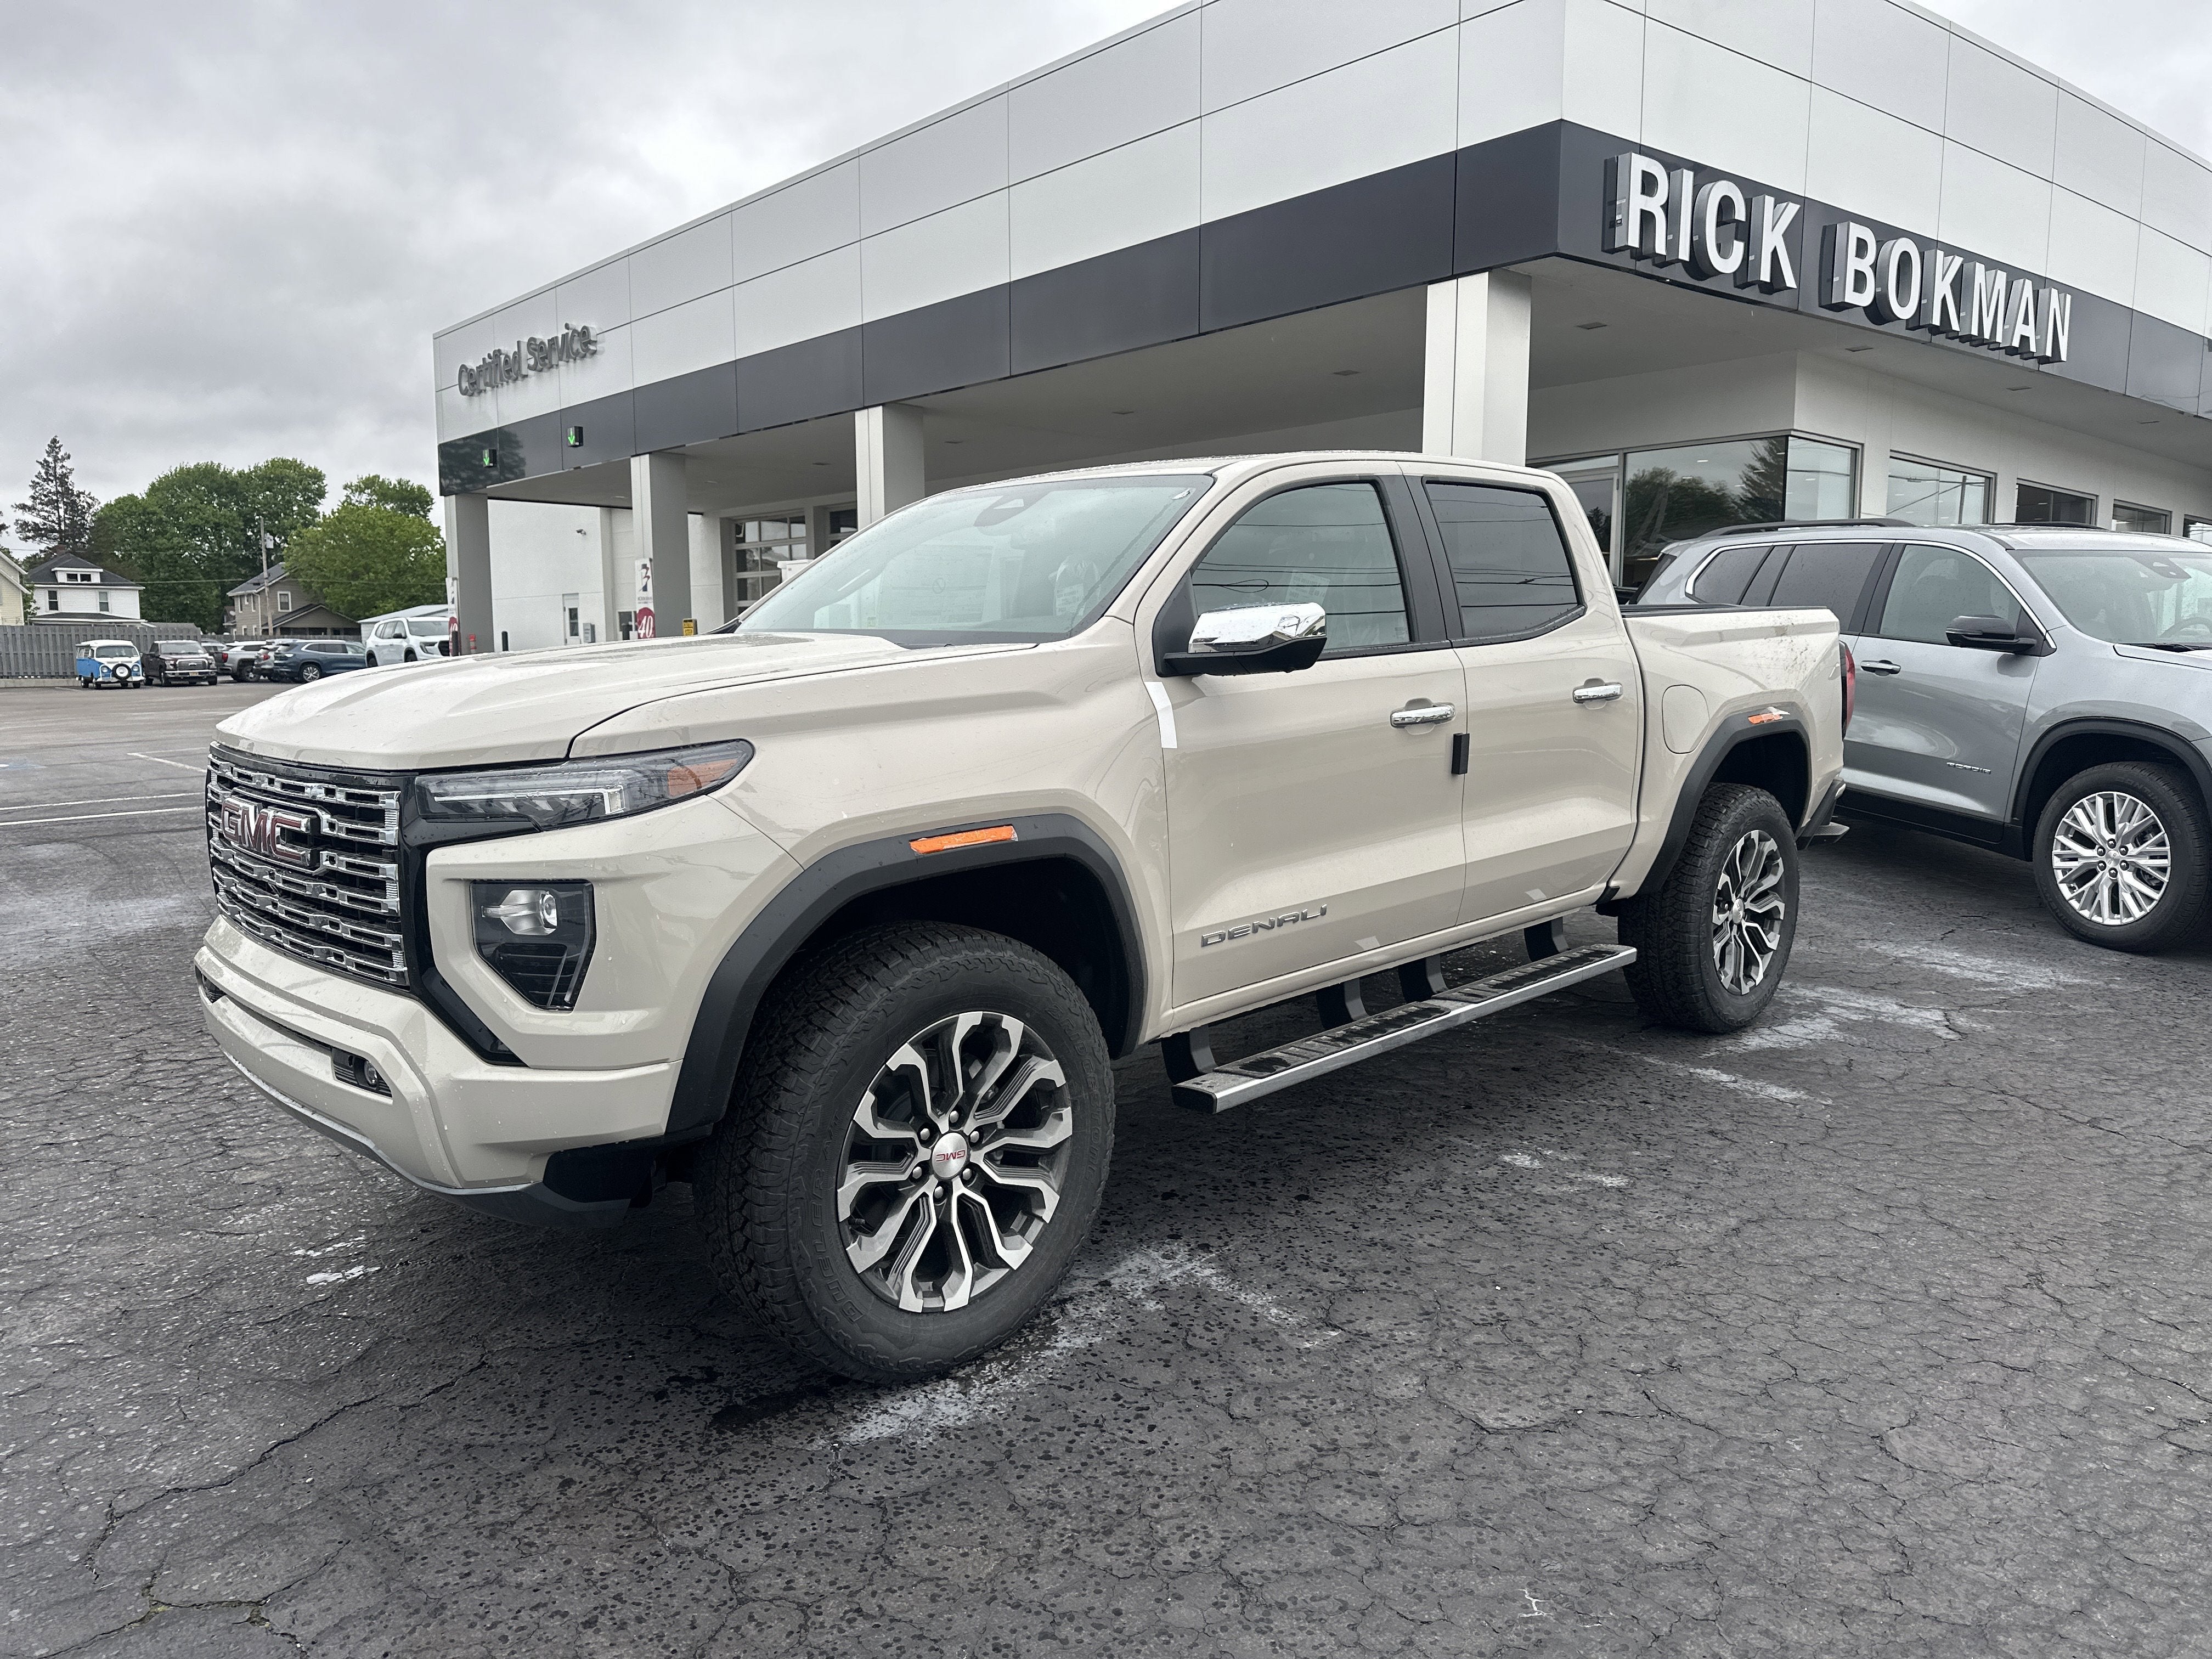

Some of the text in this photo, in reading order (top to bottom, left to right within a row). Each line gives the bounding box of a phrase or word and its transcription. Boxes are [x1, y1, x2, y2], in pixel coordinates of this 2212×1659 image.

[1617, 151, 2072, 363] RICK BOKMAN
[458, 323, 598, 396] Certified Service
[638, 616, 653, 638] 40
[222, 798, 312, 866] GMC
[1201, 904, 1327, 947] DENALI
[935, 1150, 966, 1163] GMC
[811, 1167, 865, 1323] DUELER
